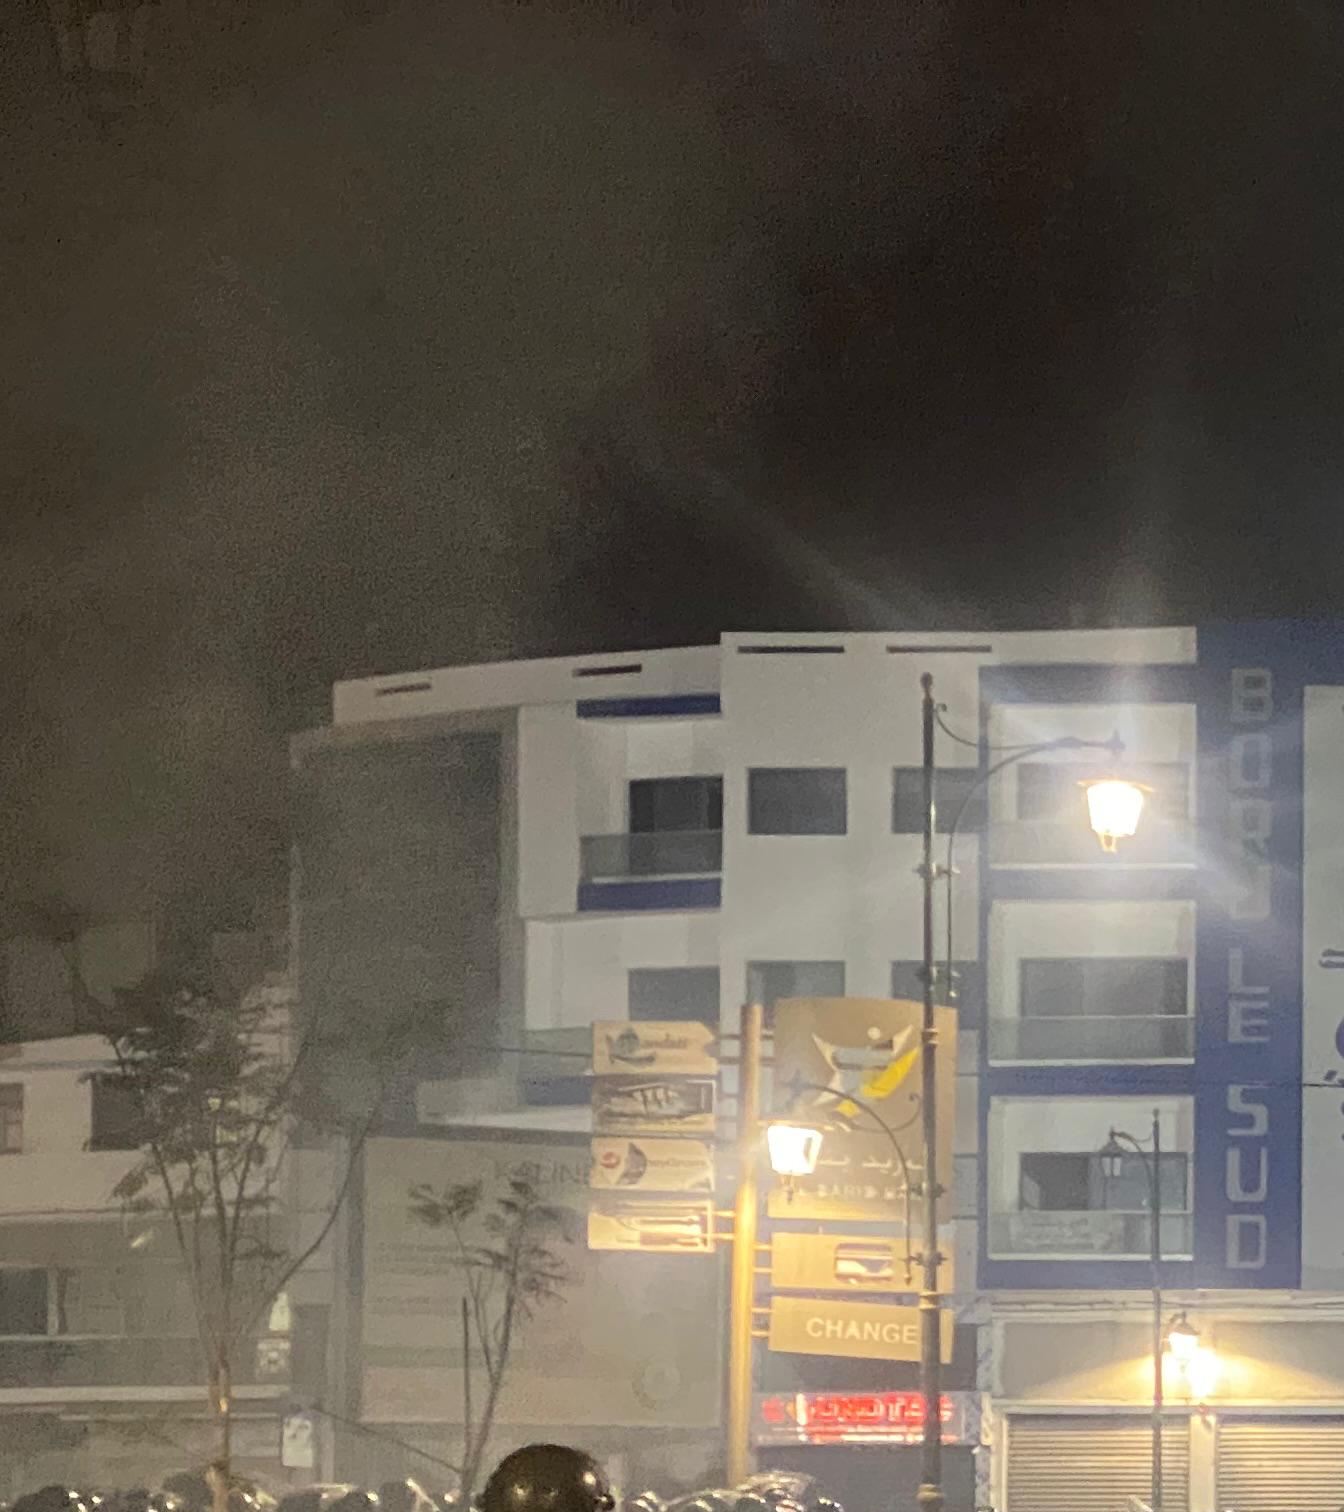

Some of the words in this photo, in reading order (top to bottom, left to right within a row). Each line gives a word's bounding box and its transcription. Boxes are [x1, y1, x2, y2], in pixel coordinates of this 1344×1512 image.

[1228, 948, 1270, 1043] LE
[1225, 1083, 1270, 1270] SUD
[805, 1316, 920, 1345] CHANGE
